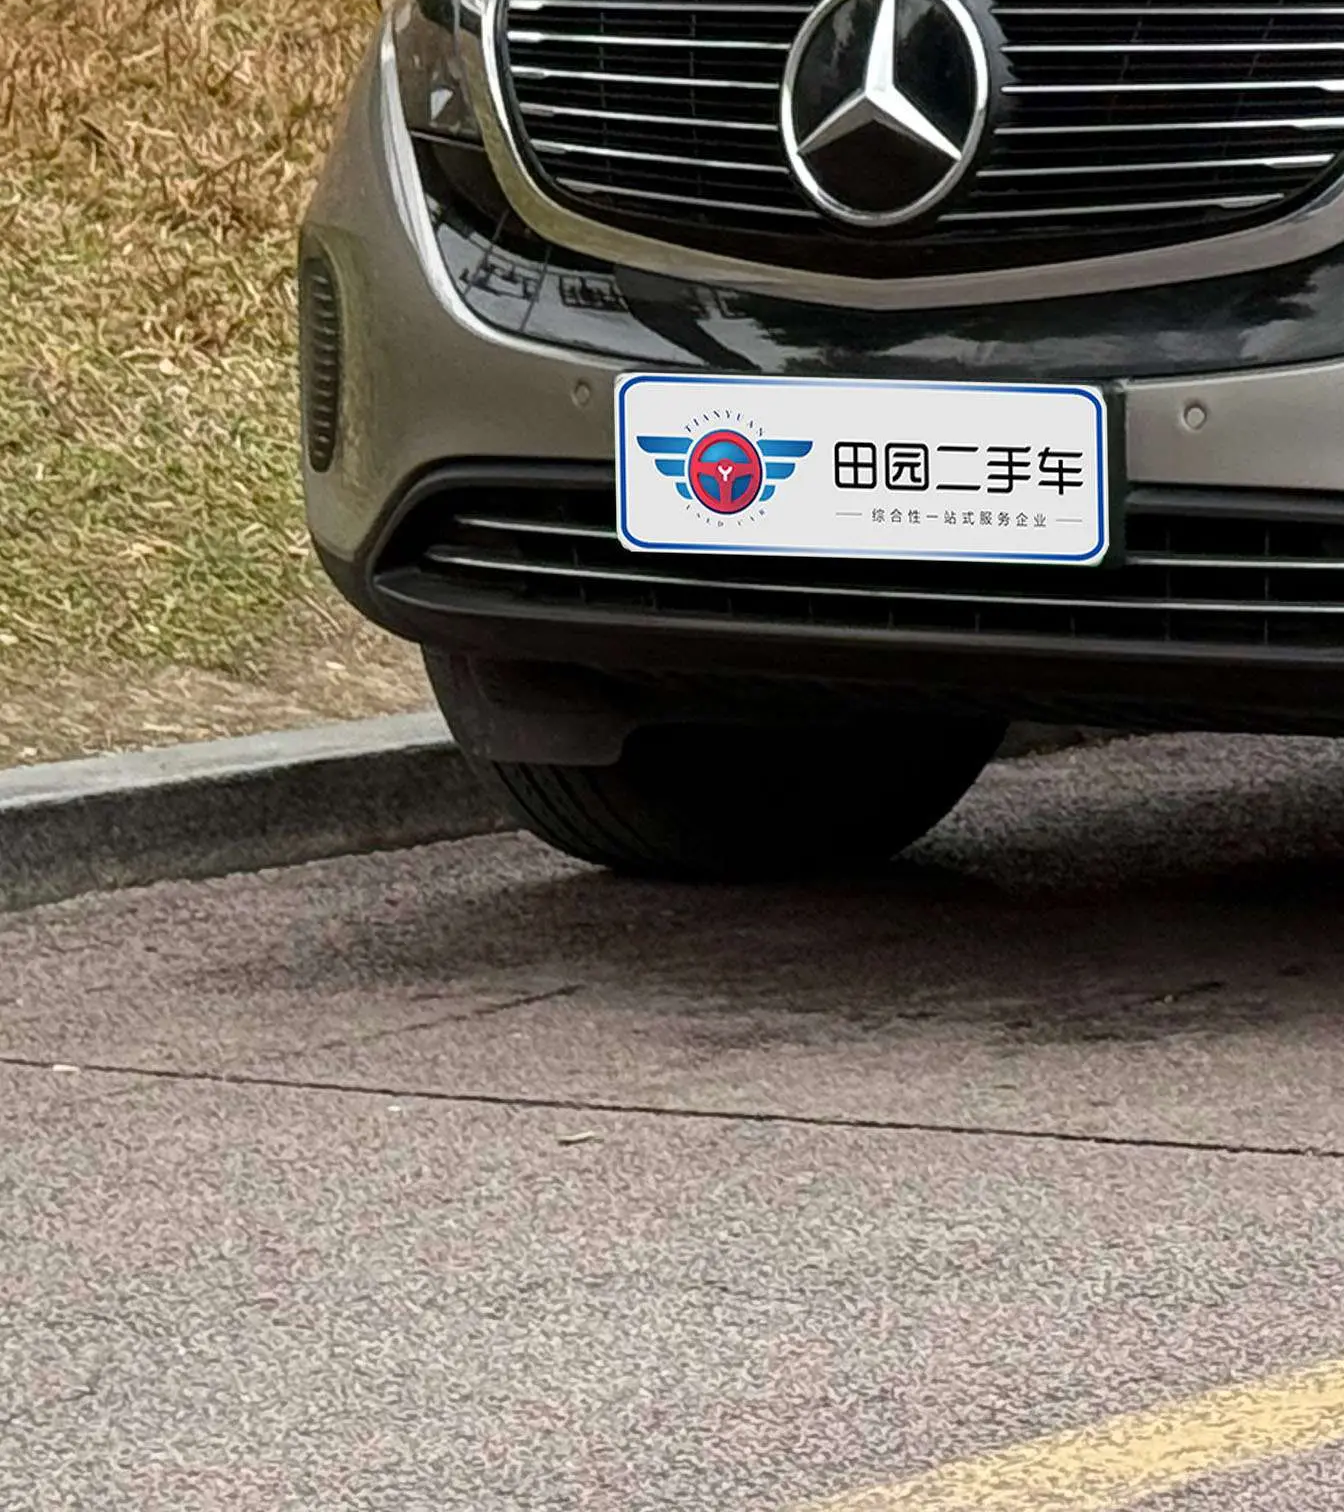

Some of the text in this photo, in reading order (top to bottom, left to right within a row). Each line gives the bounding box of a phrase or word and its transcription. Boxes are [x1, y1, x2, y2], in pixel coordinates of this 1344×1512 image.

[834, 441, 1084, 495] 田园二手车
[871, 508, 1047, 528] 综合性一站式服务企业
